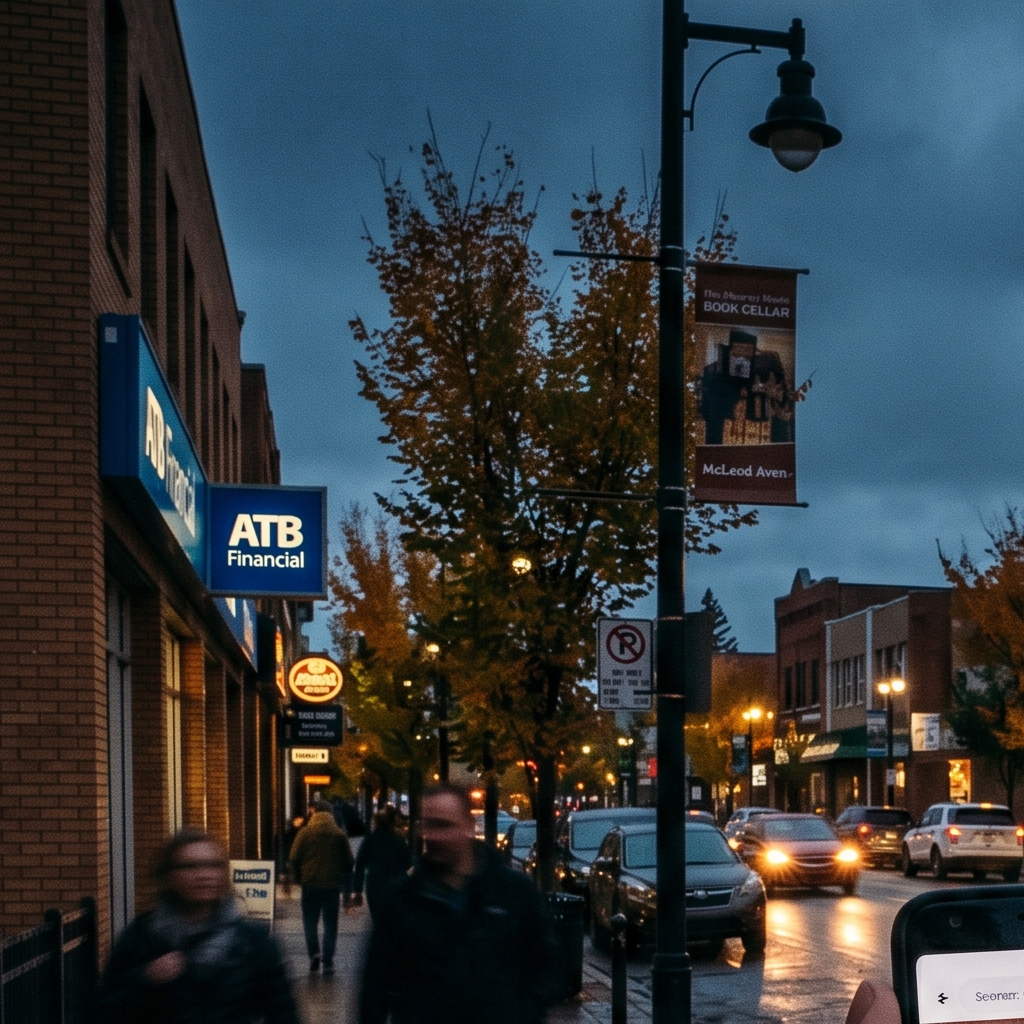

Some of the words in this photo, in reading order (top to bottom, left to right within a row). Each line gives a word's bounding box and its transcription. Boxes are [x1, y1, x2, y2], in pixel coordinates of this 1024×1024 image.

[703, 301, 739, 313] BOOK
[741, 304, 790, 318] CELLAR
[702, 463, 753, 477] McLeod
[228, 513, 304, 548] ATB
[227, 549, 305, 568] Financial
